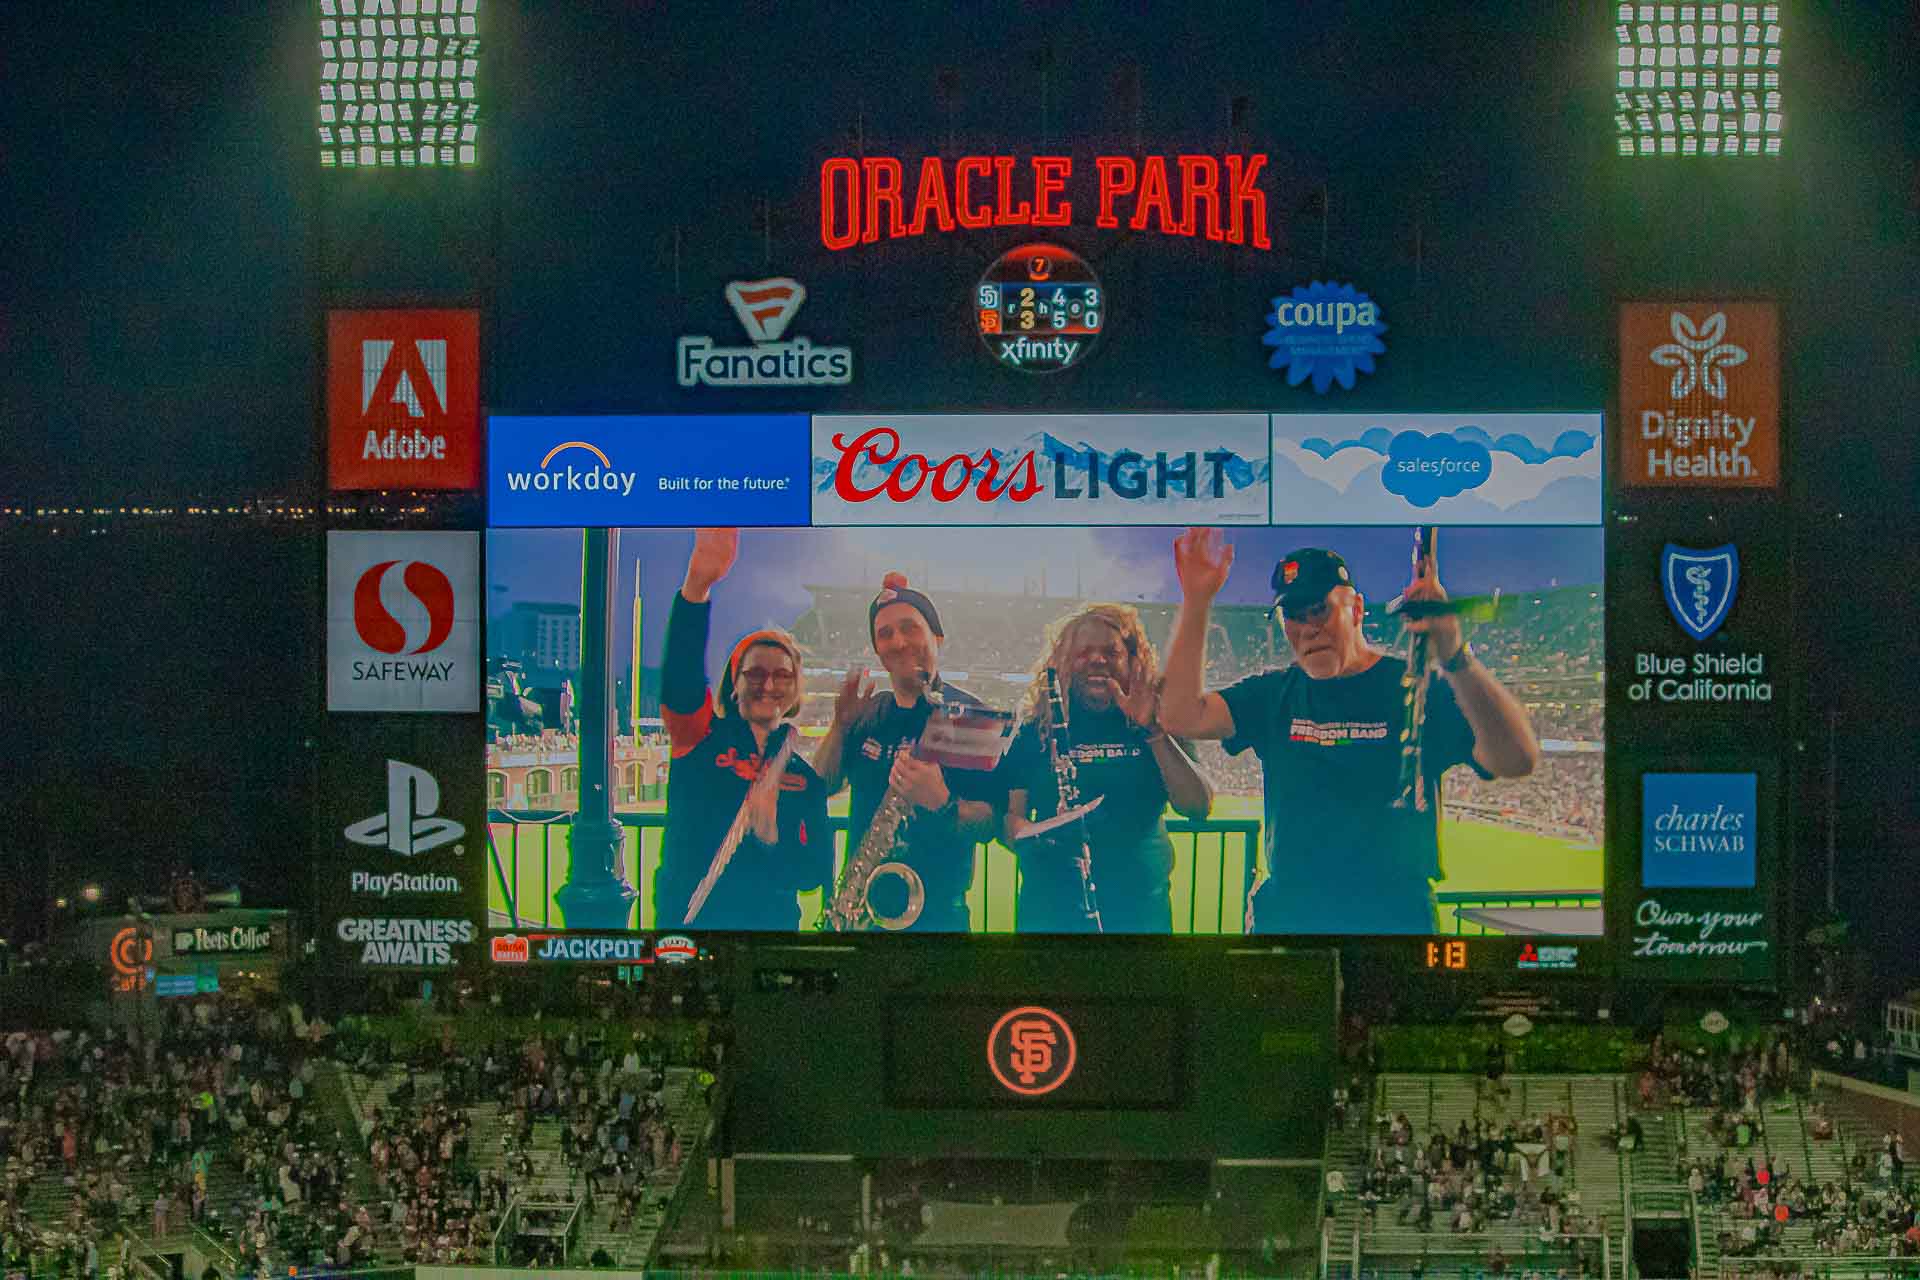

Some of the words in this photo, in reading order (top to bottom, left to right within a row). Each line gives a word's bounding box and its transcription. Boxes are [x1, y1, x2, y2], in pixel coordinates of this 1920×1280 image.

[821, 155, 1073, 250] ORACLE
[1096, 154, 1272, 250] PARK
[1034, 258, 1044, 273] 7
[1020, 287, 1035, 307] 2
[1053, 287, 1067, 307] 4
[1085, 287, 1099, 306] 3
[1020, 310, 1035, 329] 3
[1053, 310, 1066, 329] 5
[1085, 310, 1099, 329] 0
[1278, 303, 1376, 334] coupa
[681, 341, 850, 381] Fanatics
[1001, 336, 1079, 365] xfinity
[1641, 410, 1756, 448] Dignity
[362, 429, 447, 460] Adobe
[832, 427, 1044, 503] Coors
[1053, 450, 1236, 500] LIGHT
[1397, 458, 1481, 477] salesforce
[507, 465, 636, 496] workday
[658, 476, 690, 490] Built
[693, 476, 713, 490] for
[717, 476, 740, 490] the
[352, 661, 455, 682] SAFEWAY
[1636, 652, 1687, 675] Blue
[1693, 652, 1764, 675] Shield
[1628, 679, 1653, 701] of
[1657, 679, 1773, 701] California
[1654, 803, 1745, 832] charles
[1655, 835, 1745, 853] SCHWAB
[351, 871, 460, 897] PlayStation
[337, 917, 473, 942] GREATNESS
[1636, 899, 1694, 926] Own
[1696, 910, 1763, 938] your
[230, 925, 271, 951] Coffee
[538, 937, 645, 960] JACKPOT
[1633, 931, 1769, 957] tomorrow
